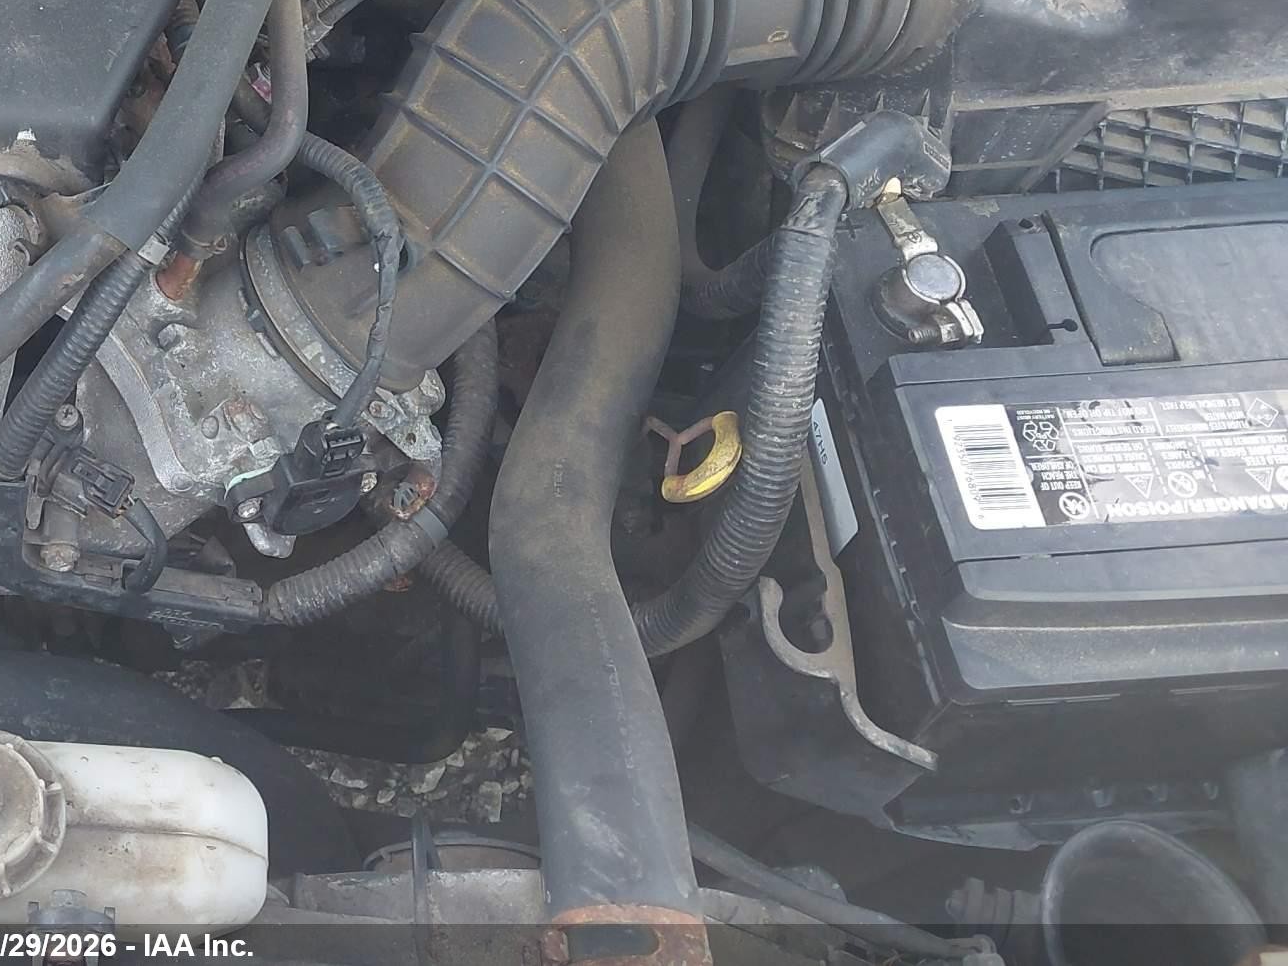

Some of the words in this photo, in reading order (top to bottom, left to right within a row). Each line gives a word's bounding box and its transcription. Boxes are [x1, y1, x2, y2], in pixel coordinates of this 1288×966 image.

[1040, 481, 1050, 491] OF
[1050, 481, 1061, 490] OUT
[1061, 481, 1083, 491] KEEP
[1106, 495, 1274, 517] DANGER/POISON
